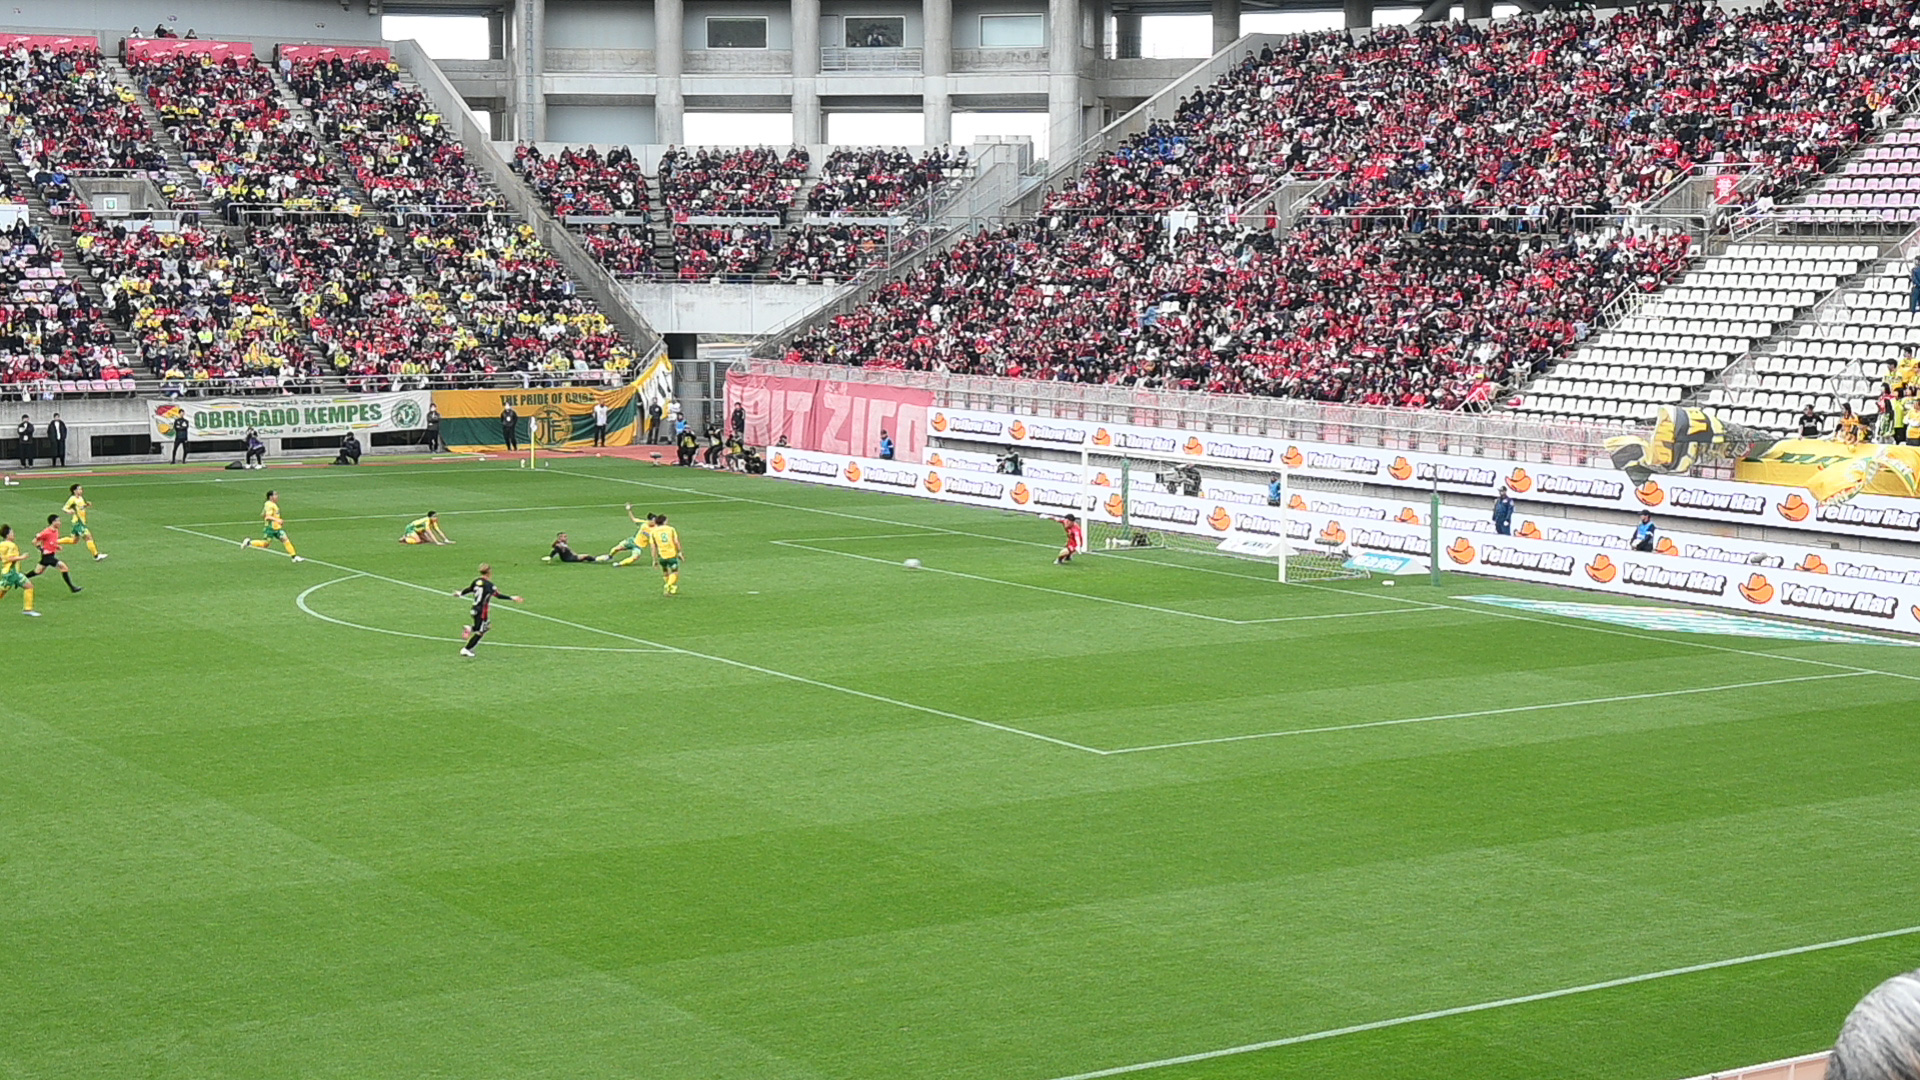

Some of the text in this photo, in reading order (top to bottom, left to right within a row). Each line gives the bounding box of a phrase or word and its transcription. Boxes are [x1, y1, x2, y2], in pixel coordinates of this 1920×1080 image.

[519, 393, 549, 406] PRIDE
[551, 392, 562, 404] OF
[194, 403, 382, 429] OBRIGADO KEMPES
